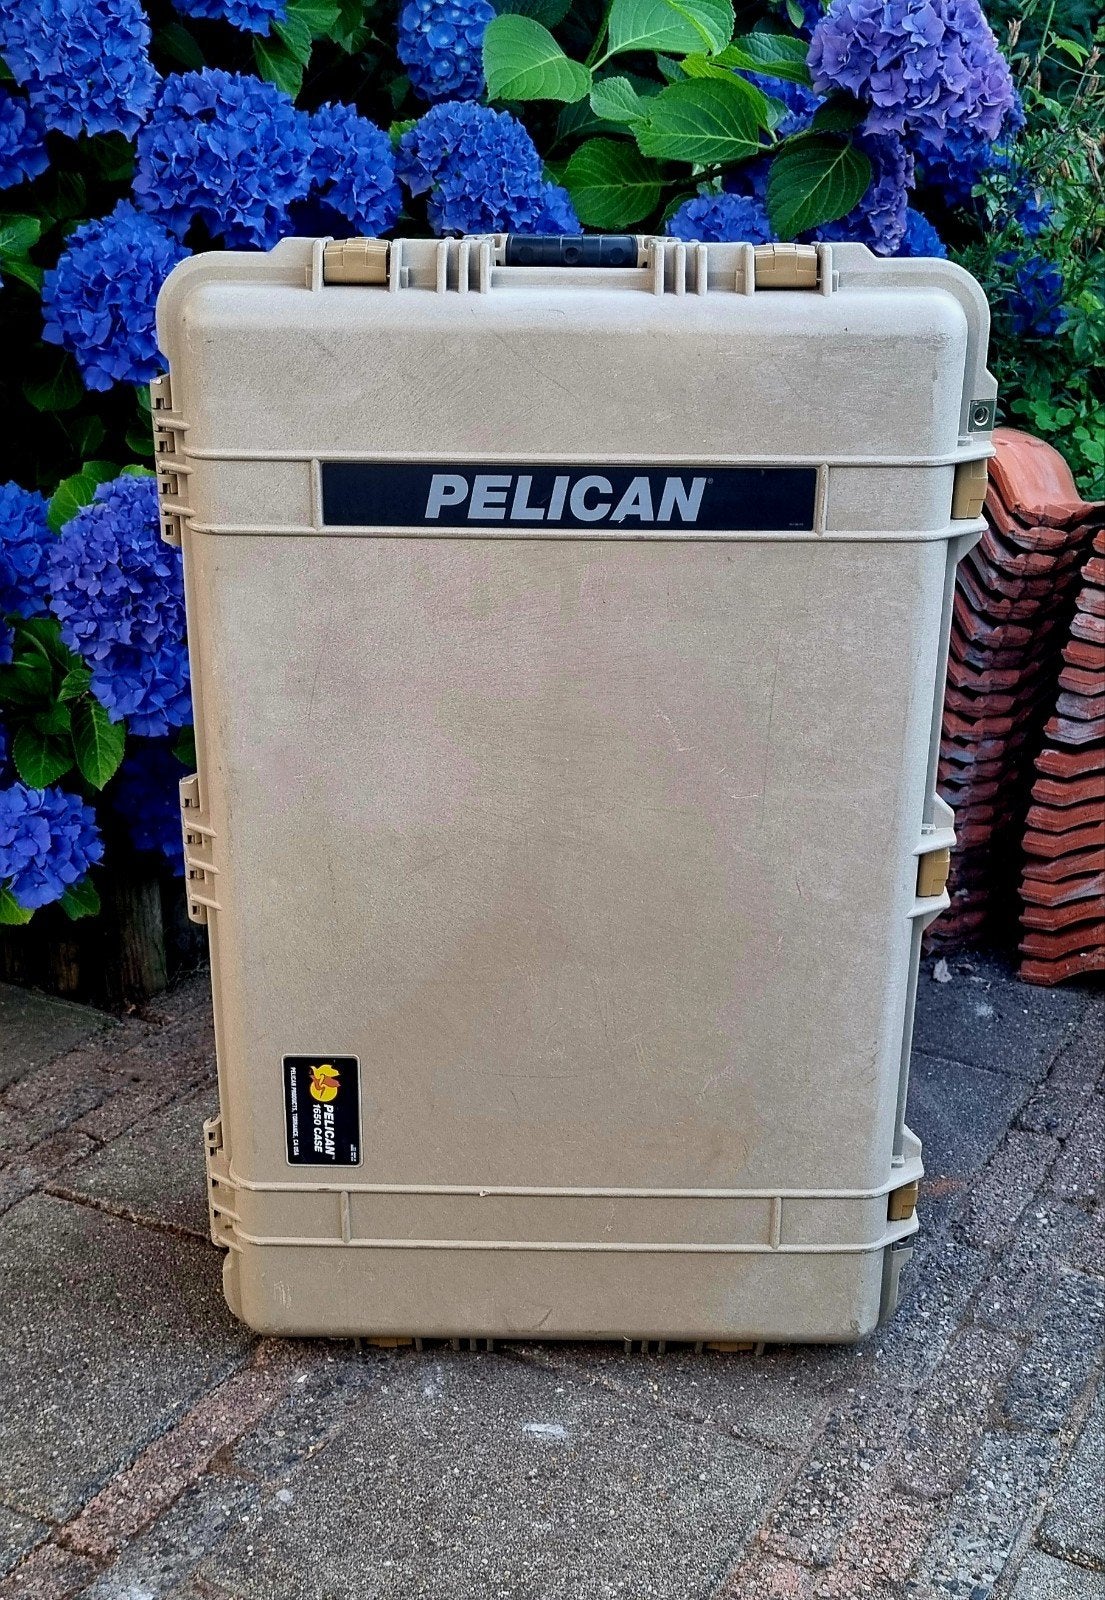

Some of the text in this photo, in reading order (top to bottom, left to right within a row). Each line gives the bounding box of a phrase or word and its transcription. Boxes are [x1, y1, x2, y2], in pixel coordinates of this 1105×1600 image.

[425, 474, 706, 522] PELICAN
[312, 1103, 323, 1153] 1650 CASE
